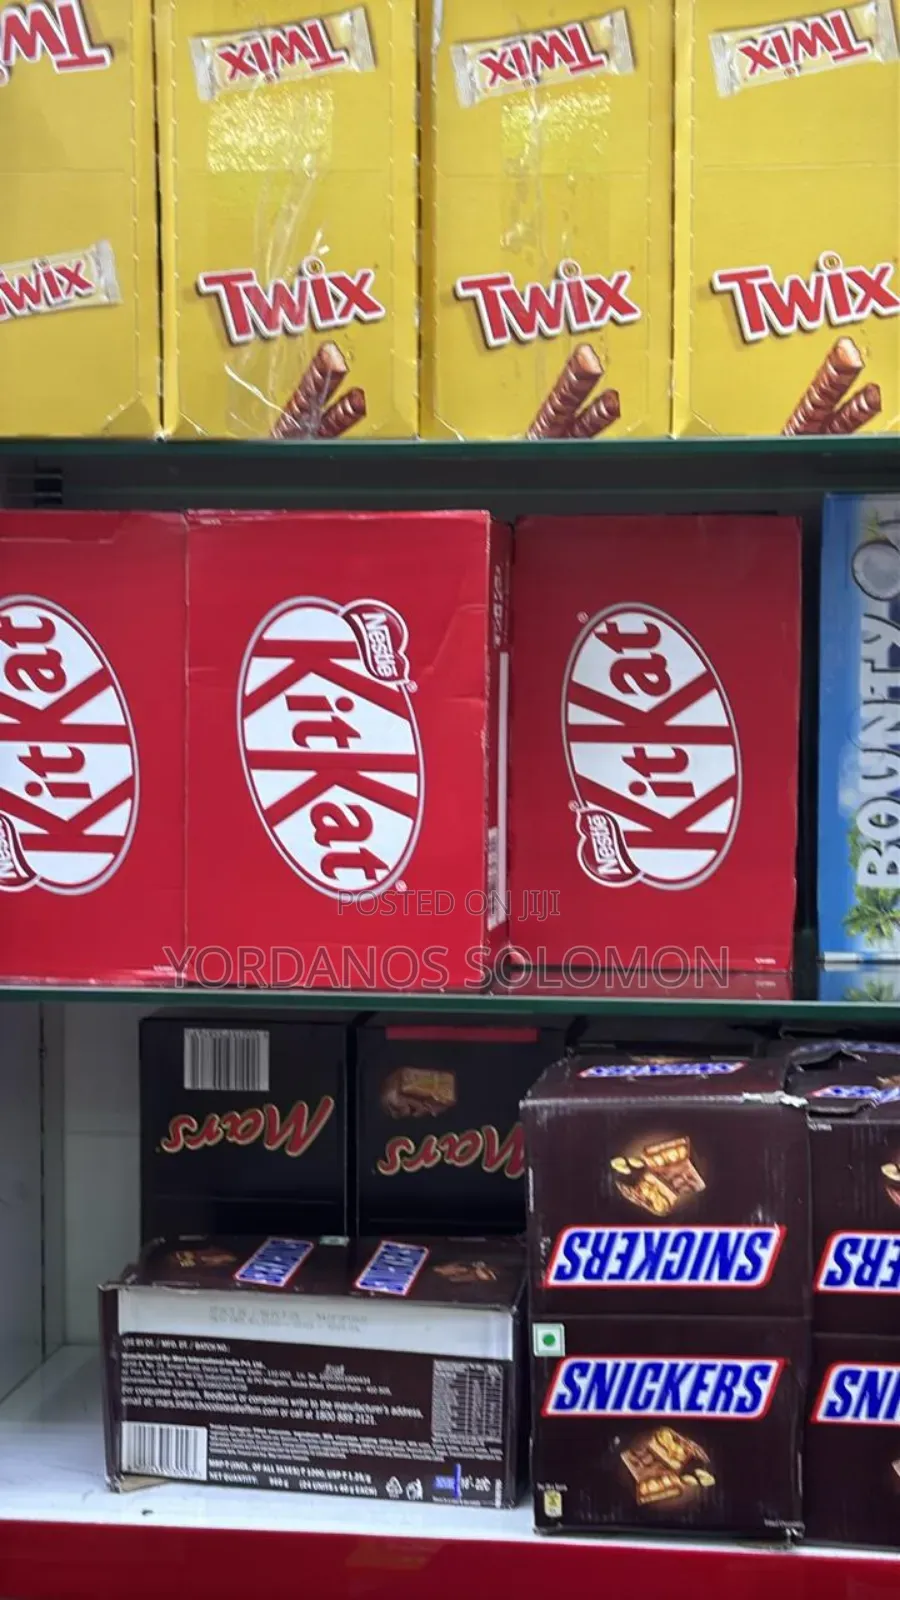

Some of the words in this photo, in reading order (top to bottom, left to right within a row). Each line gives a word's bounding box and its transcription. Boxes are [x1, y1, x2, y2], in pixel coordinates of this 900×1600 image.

[0, 259, 95, 319] wix
[162, 1095, 334, 1157] Mars
[553, 1229, 775, 1283] SNICKERS
[552, 1361, 771, 1414] SNICKERS
